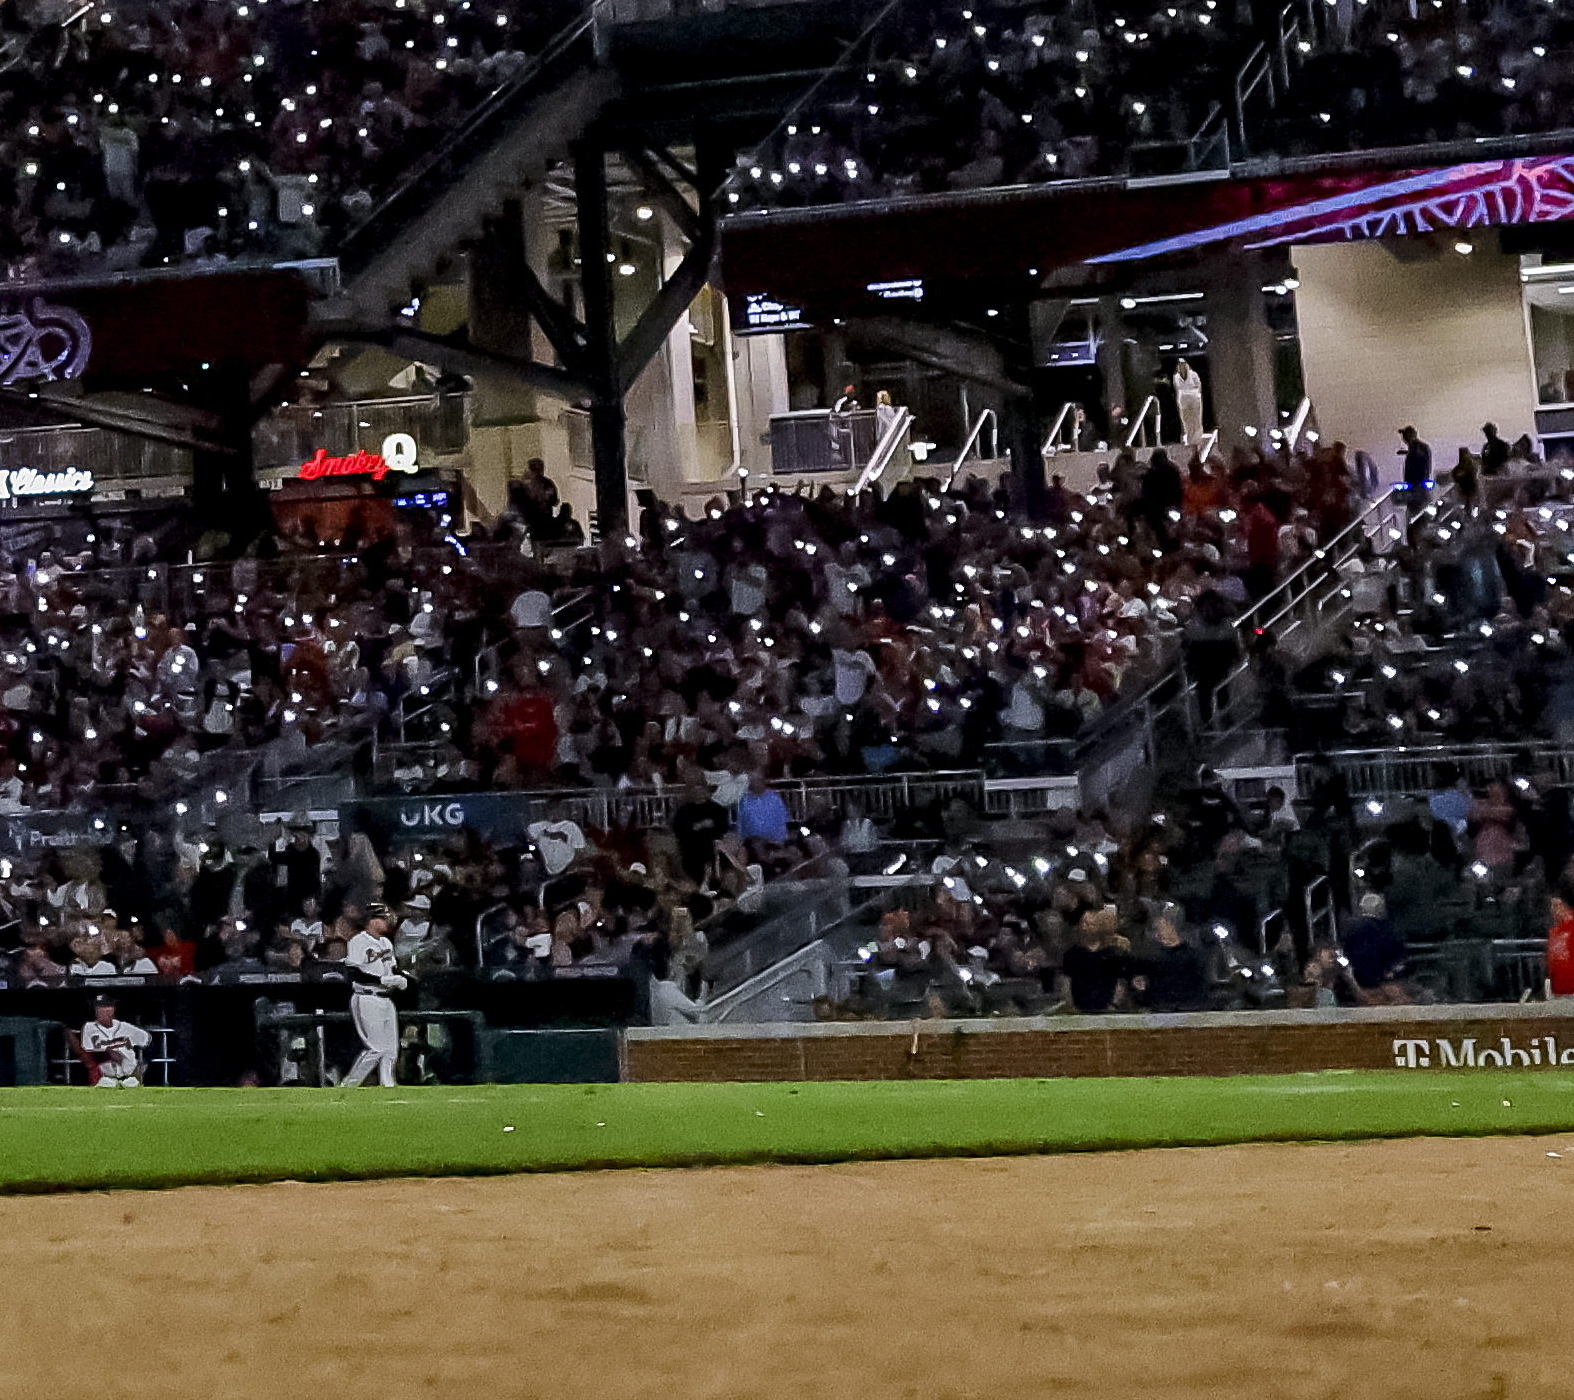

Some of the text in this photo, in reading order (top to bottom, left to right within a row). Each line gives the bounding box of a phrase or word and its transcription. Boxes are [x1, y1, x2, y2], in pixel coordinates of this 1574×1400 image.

[299, 432, 420, 481] Smokey Q
[10, 467, 94, 495] Classics
